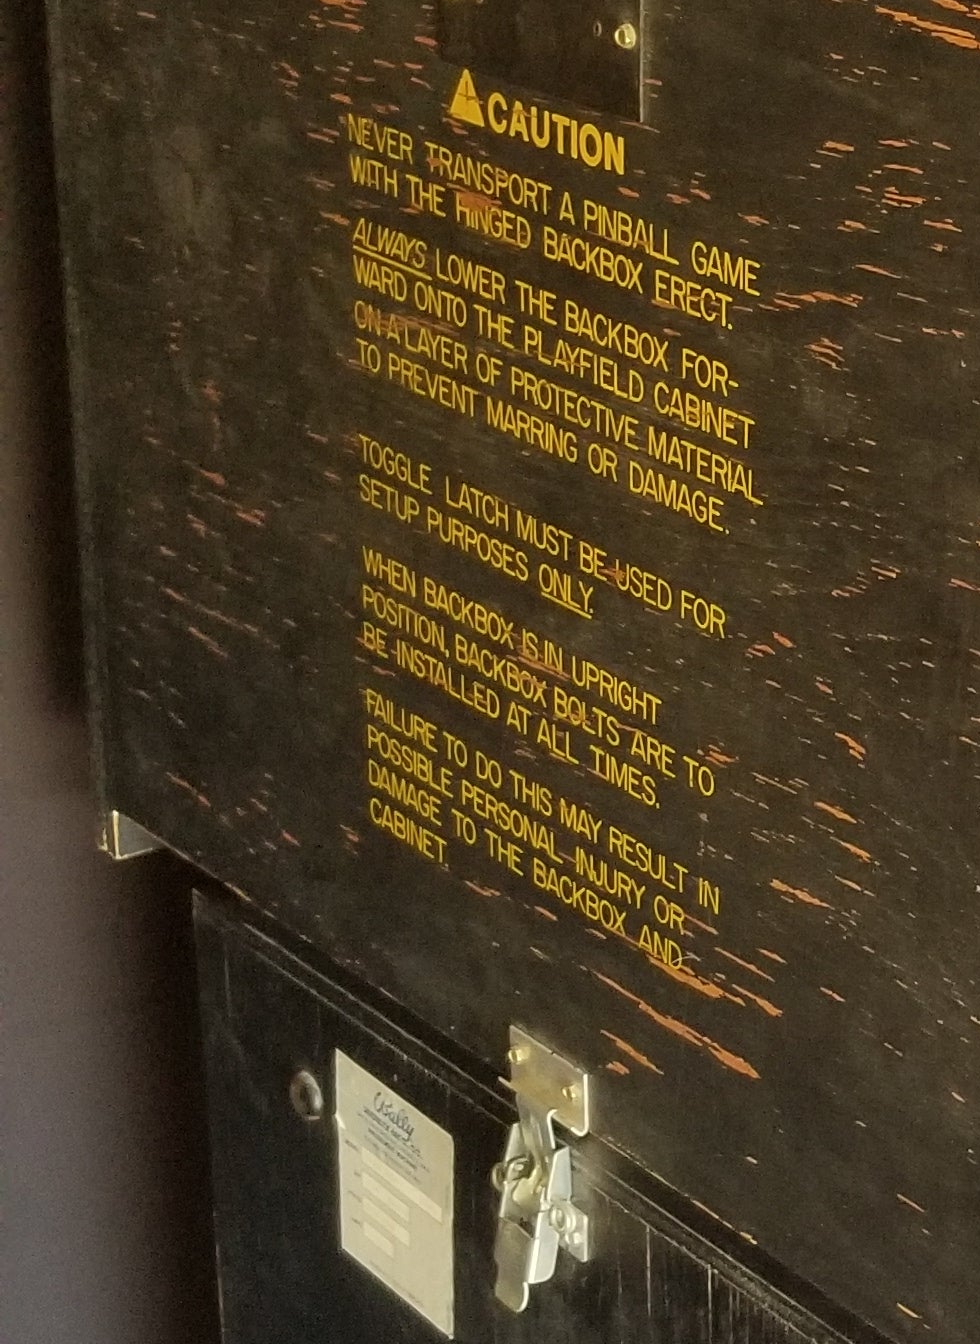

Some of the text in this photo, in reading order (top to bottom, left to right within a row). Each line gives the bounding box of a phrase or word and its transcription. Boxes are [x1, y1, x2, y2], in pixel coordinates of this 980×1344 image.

[347, 113, 761, 297] NEVER TRANSPORT A PINBALL GAME
[487, 92, 625, 176] CAUTION
[348, 154, 734, 331] WITH THE HINGED BACKBOX ERECT.
[352, 217, 740, 397] ALWAYS LOWER THE BACKBOX FOR-
[352, 255, 756, 449] WARD ONTO THE PLAYFIELD CABINET
[353, 301, 764, 507] ON A LAYER OF PROTECTIVE MATERIAL
[355, 337, 731, 536] TO PREVENT MARRING OR DAMAGE.
[358, 433, 726, 639] TOGGLE LATCH MUST BE USED FOR
[358, 474, 595, 614] SETUP PURPOSES ONLY.
[361, 545, 662, 726] WHEN BACKBOX IS IN UPRIGHT
[361, 585, 715, 796] POSITION, BACKBOX BOLTS ARE TO
[361, 621, 661, 809] BE INSTALLED AT ALL TIMES.
[364, 688, 721, 915] FAILURE TO DO THIS MAY RESULT IN
[367, 725, 686, 937] POSSIBLE PERSONAL INJURY OR
[367, 761, 682, 971] DAMAGE TO THE BACKBOX AND
